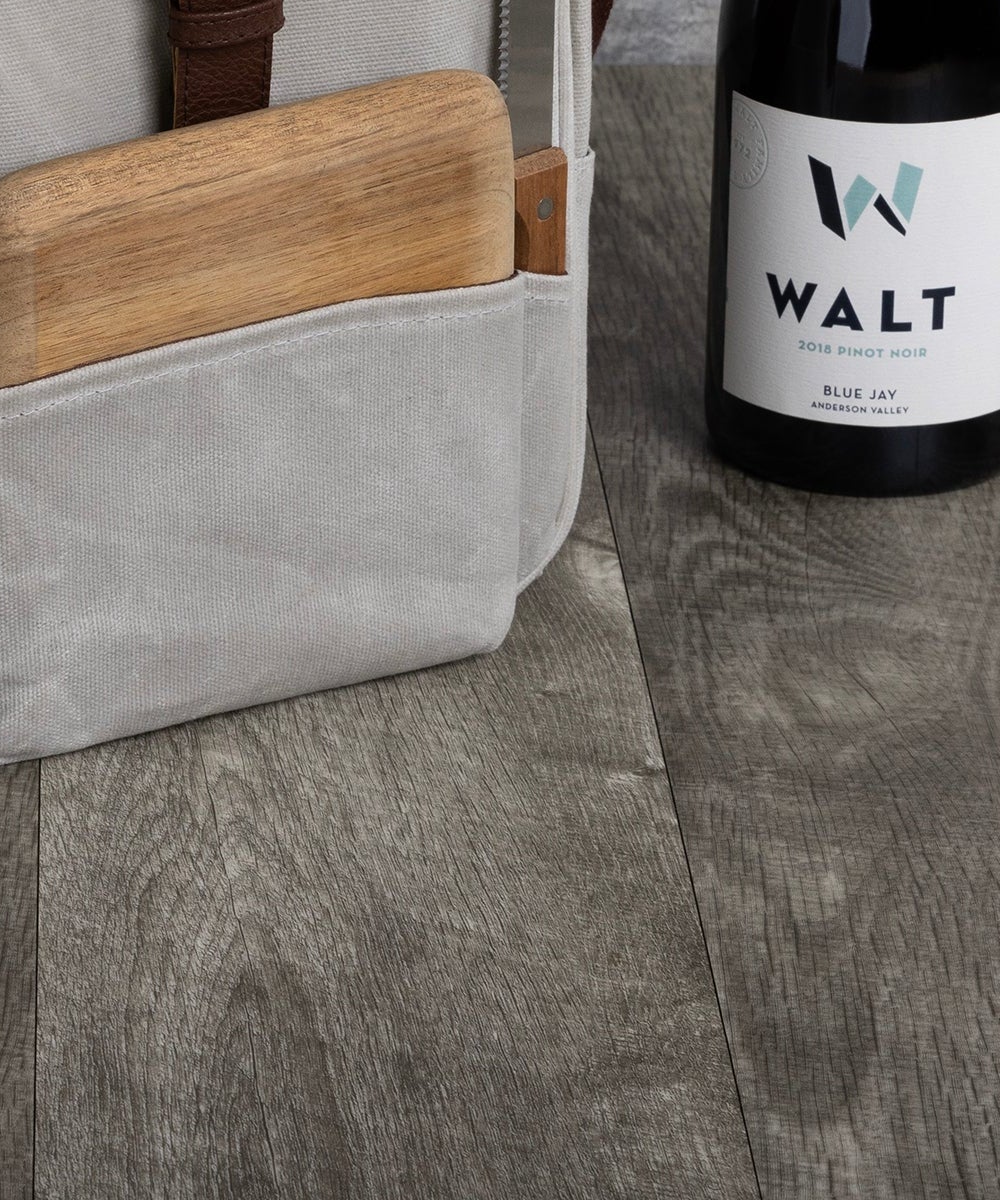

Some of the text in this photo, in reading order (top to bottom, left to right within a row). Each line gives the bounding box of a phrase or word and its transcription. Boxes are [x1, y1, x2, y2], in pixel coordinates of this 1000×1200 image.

[765, 271, 956, 333] WALT
[798, 340, 927, 359] 2018 PINOT NOIR
[823, 385, 898, 401] BLUE JAY
[810, 401, 910, 415] ANDERSON VALLEY
